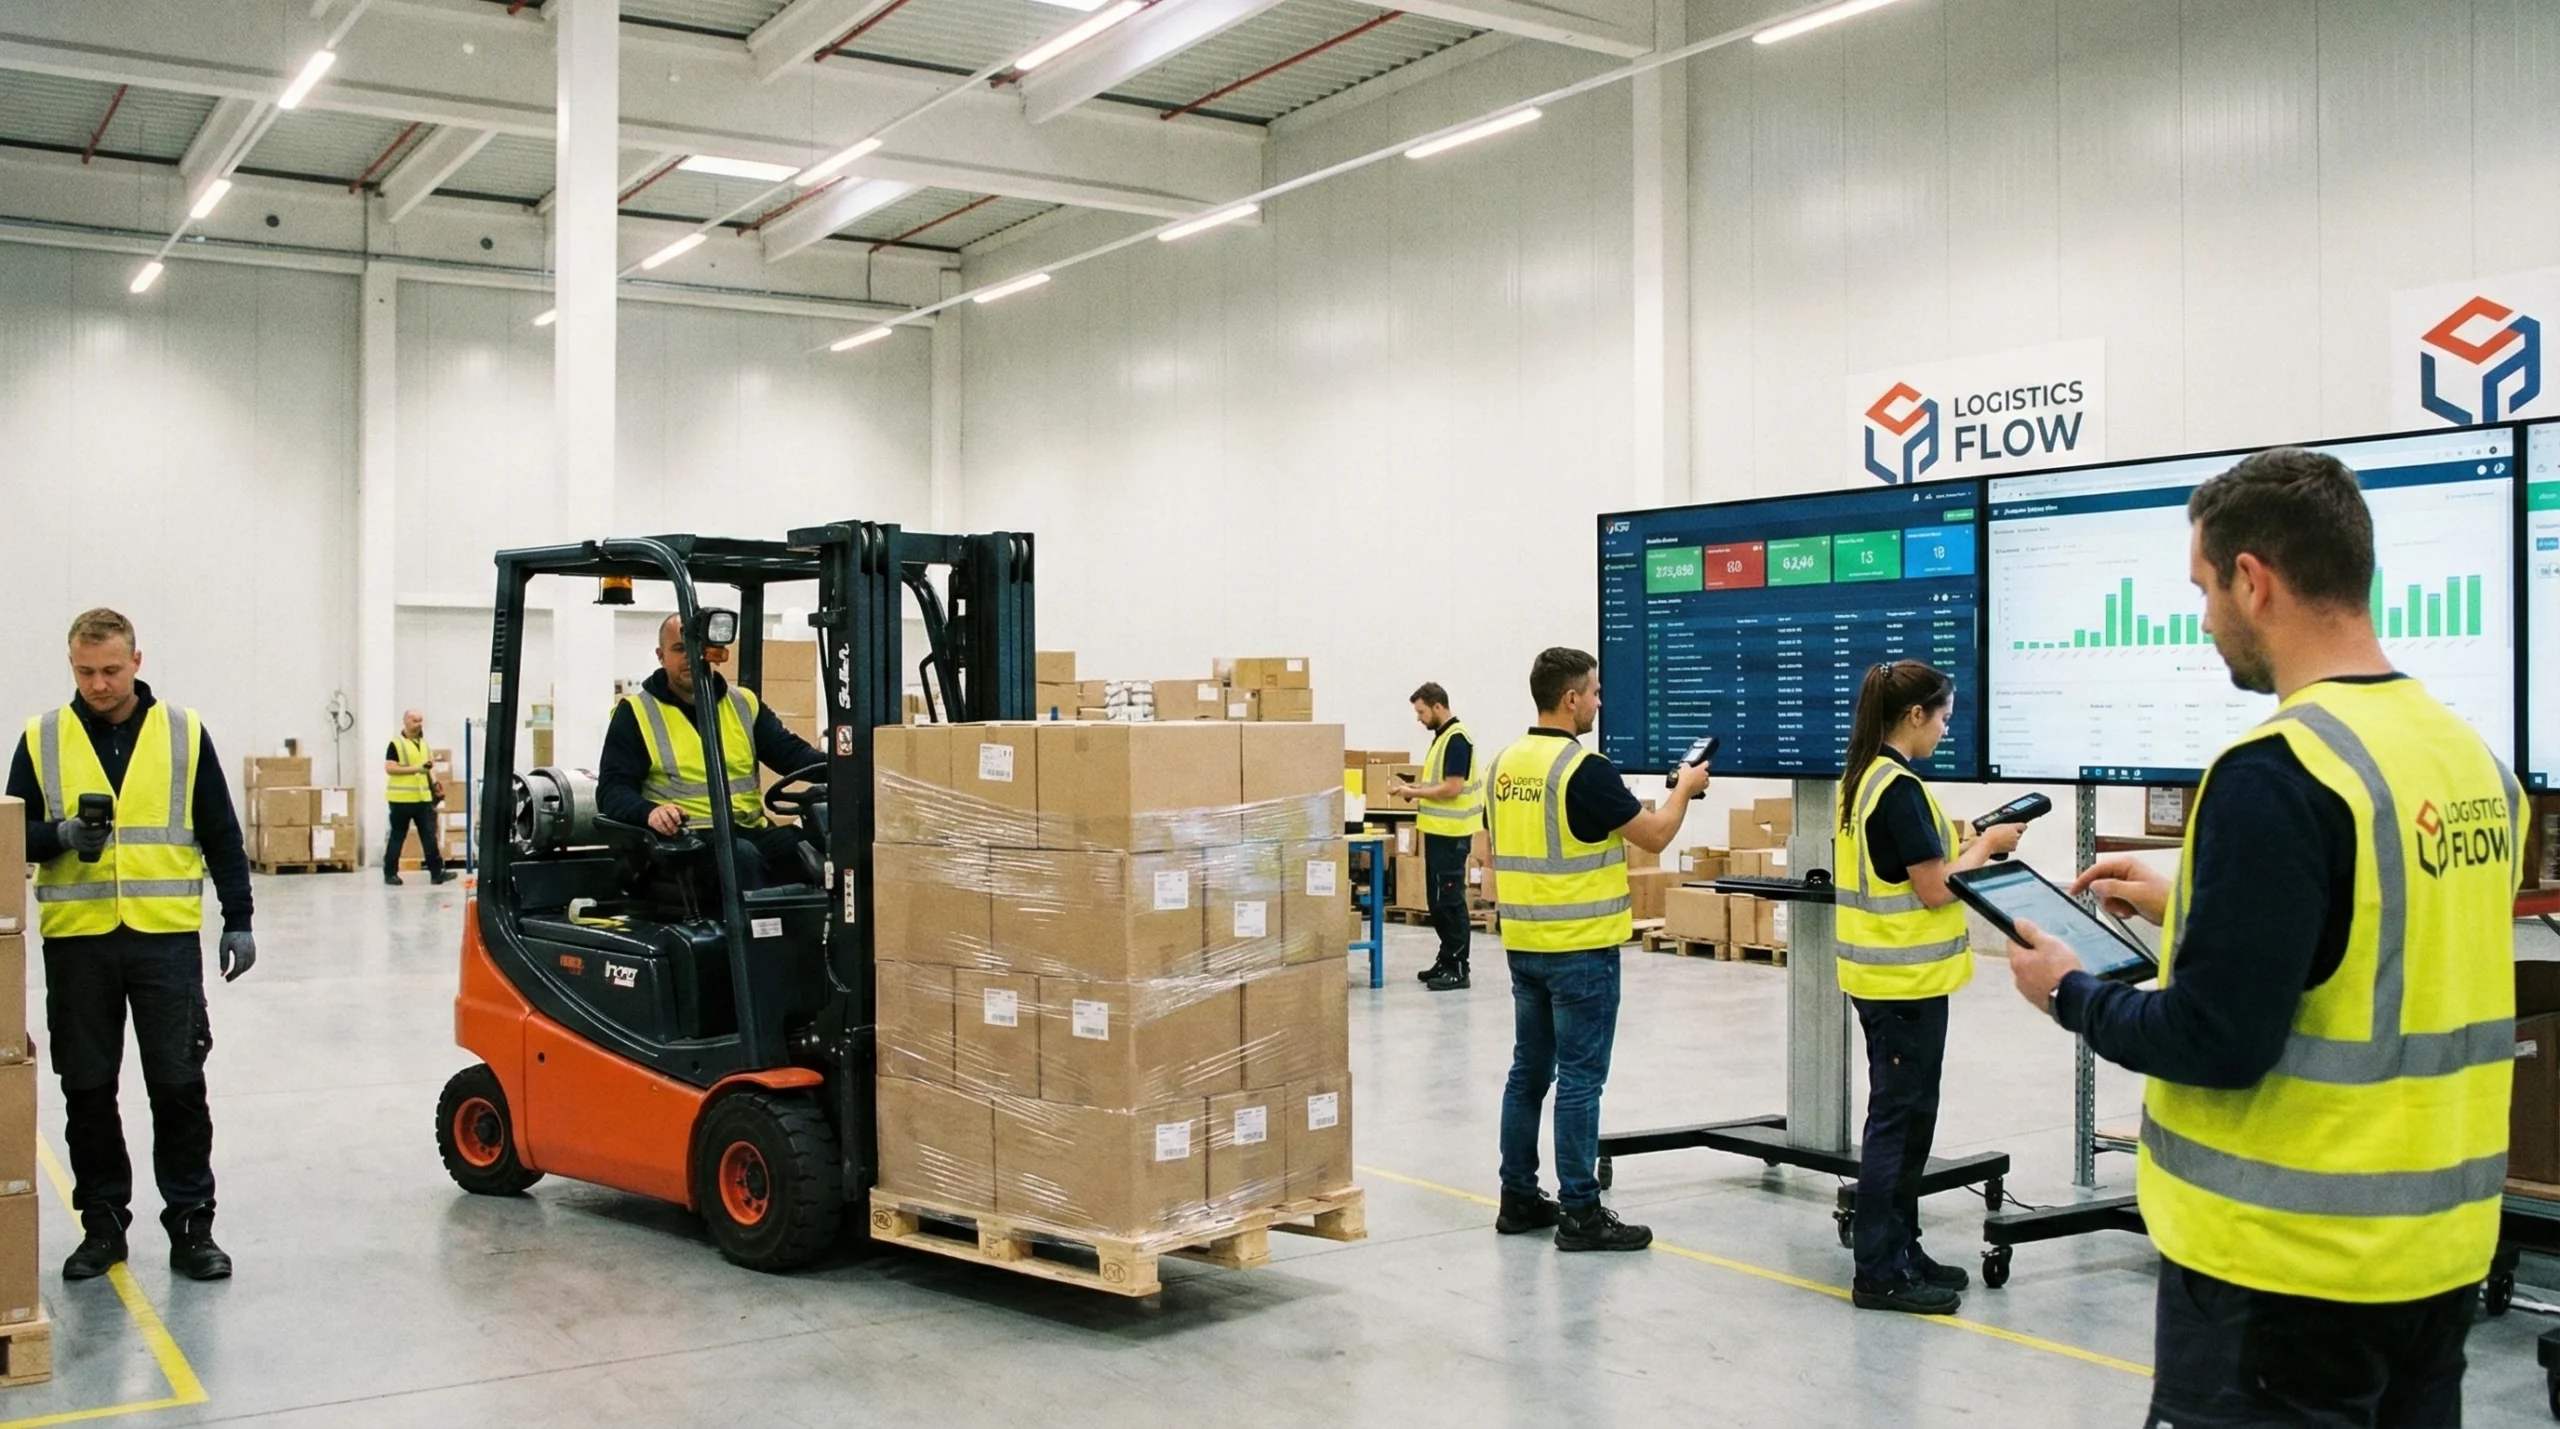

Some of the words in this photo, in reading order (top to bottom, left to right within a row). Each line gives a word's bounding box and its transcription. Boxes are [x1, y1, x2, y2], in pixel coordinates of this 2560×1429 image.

[1954, 380, 2083, 418] LOGISTICS
[1955, 411, 2083, 462] FLOW
[1511, 787, 1542, 802] FLOW
[2444, 797, 2507, 824] LOGISTICS
[2452, 826, 2509, 868] FLOW
